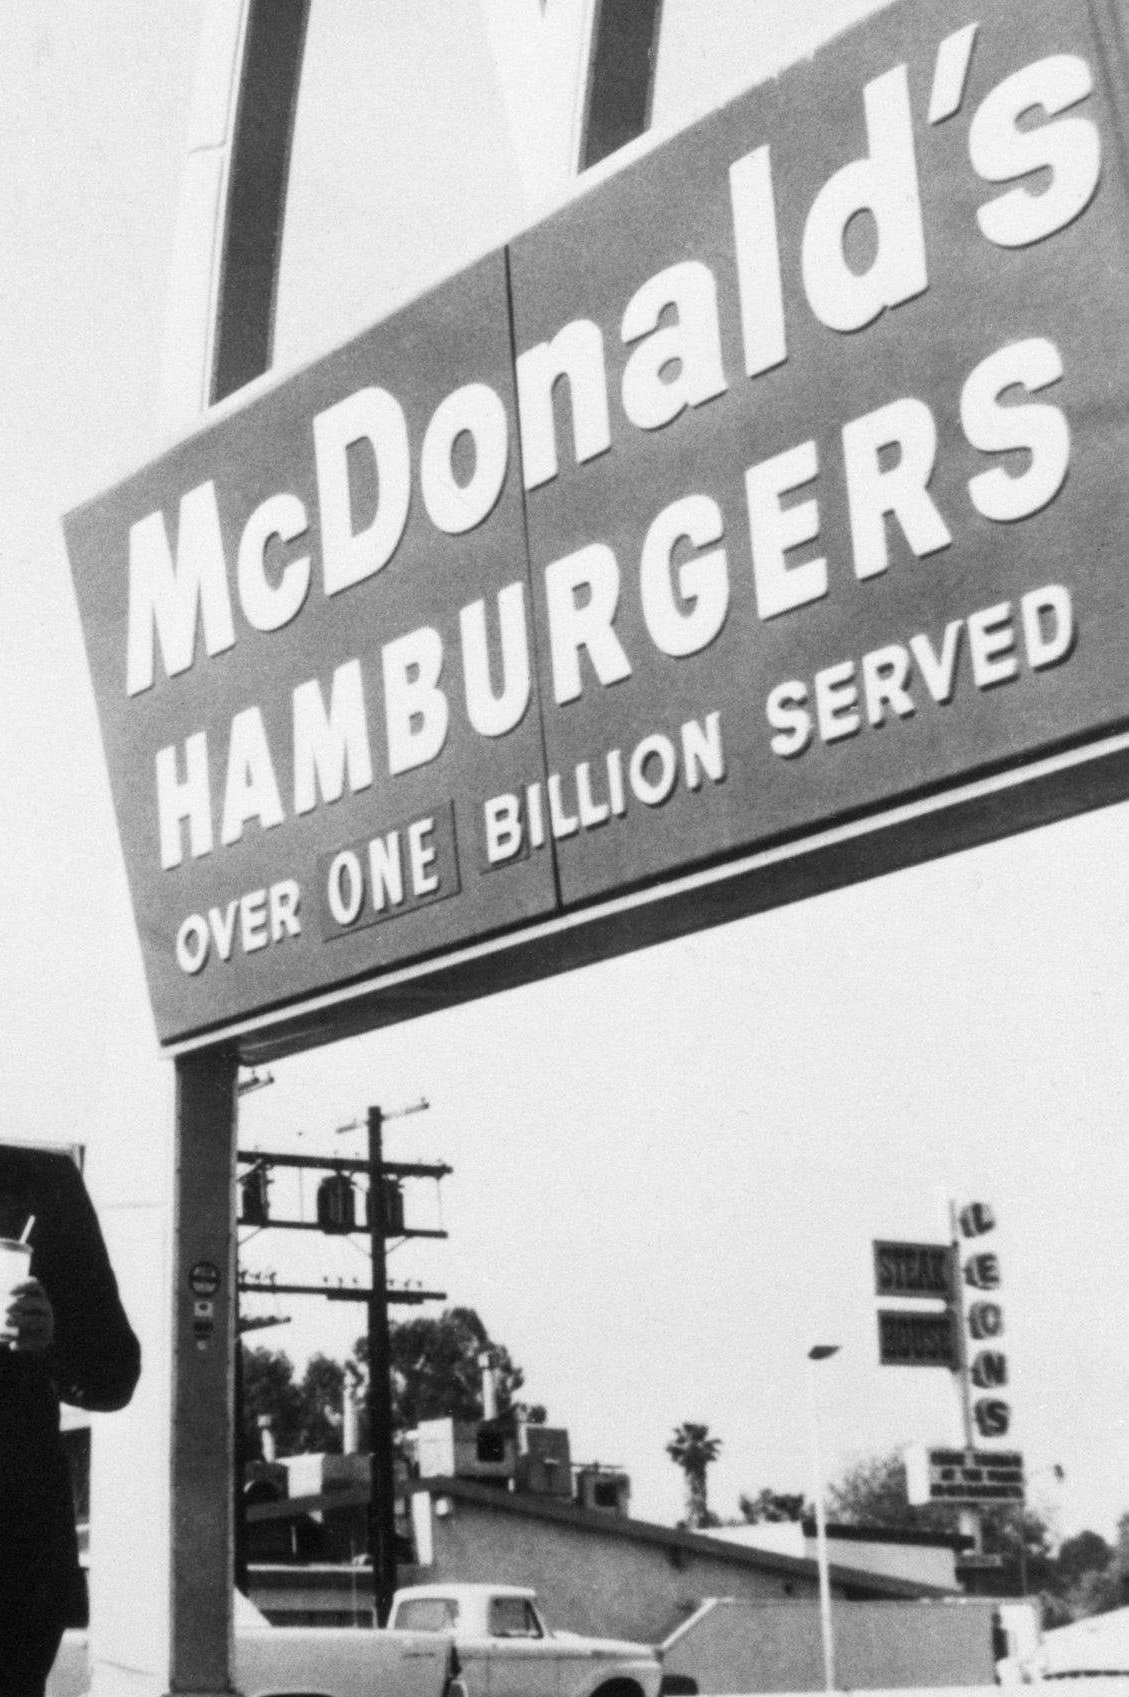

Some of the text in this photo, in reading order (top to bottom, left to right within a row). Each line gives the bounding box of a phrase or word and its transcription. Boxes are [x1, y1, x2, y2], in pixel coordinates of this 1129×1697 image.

[124, 21, 1102, 697] McDonald's
[155, 337, 1071, 870] HAMBURGERS
[175, 585, 1076, 976] OVER ONE BILLION SERVED
